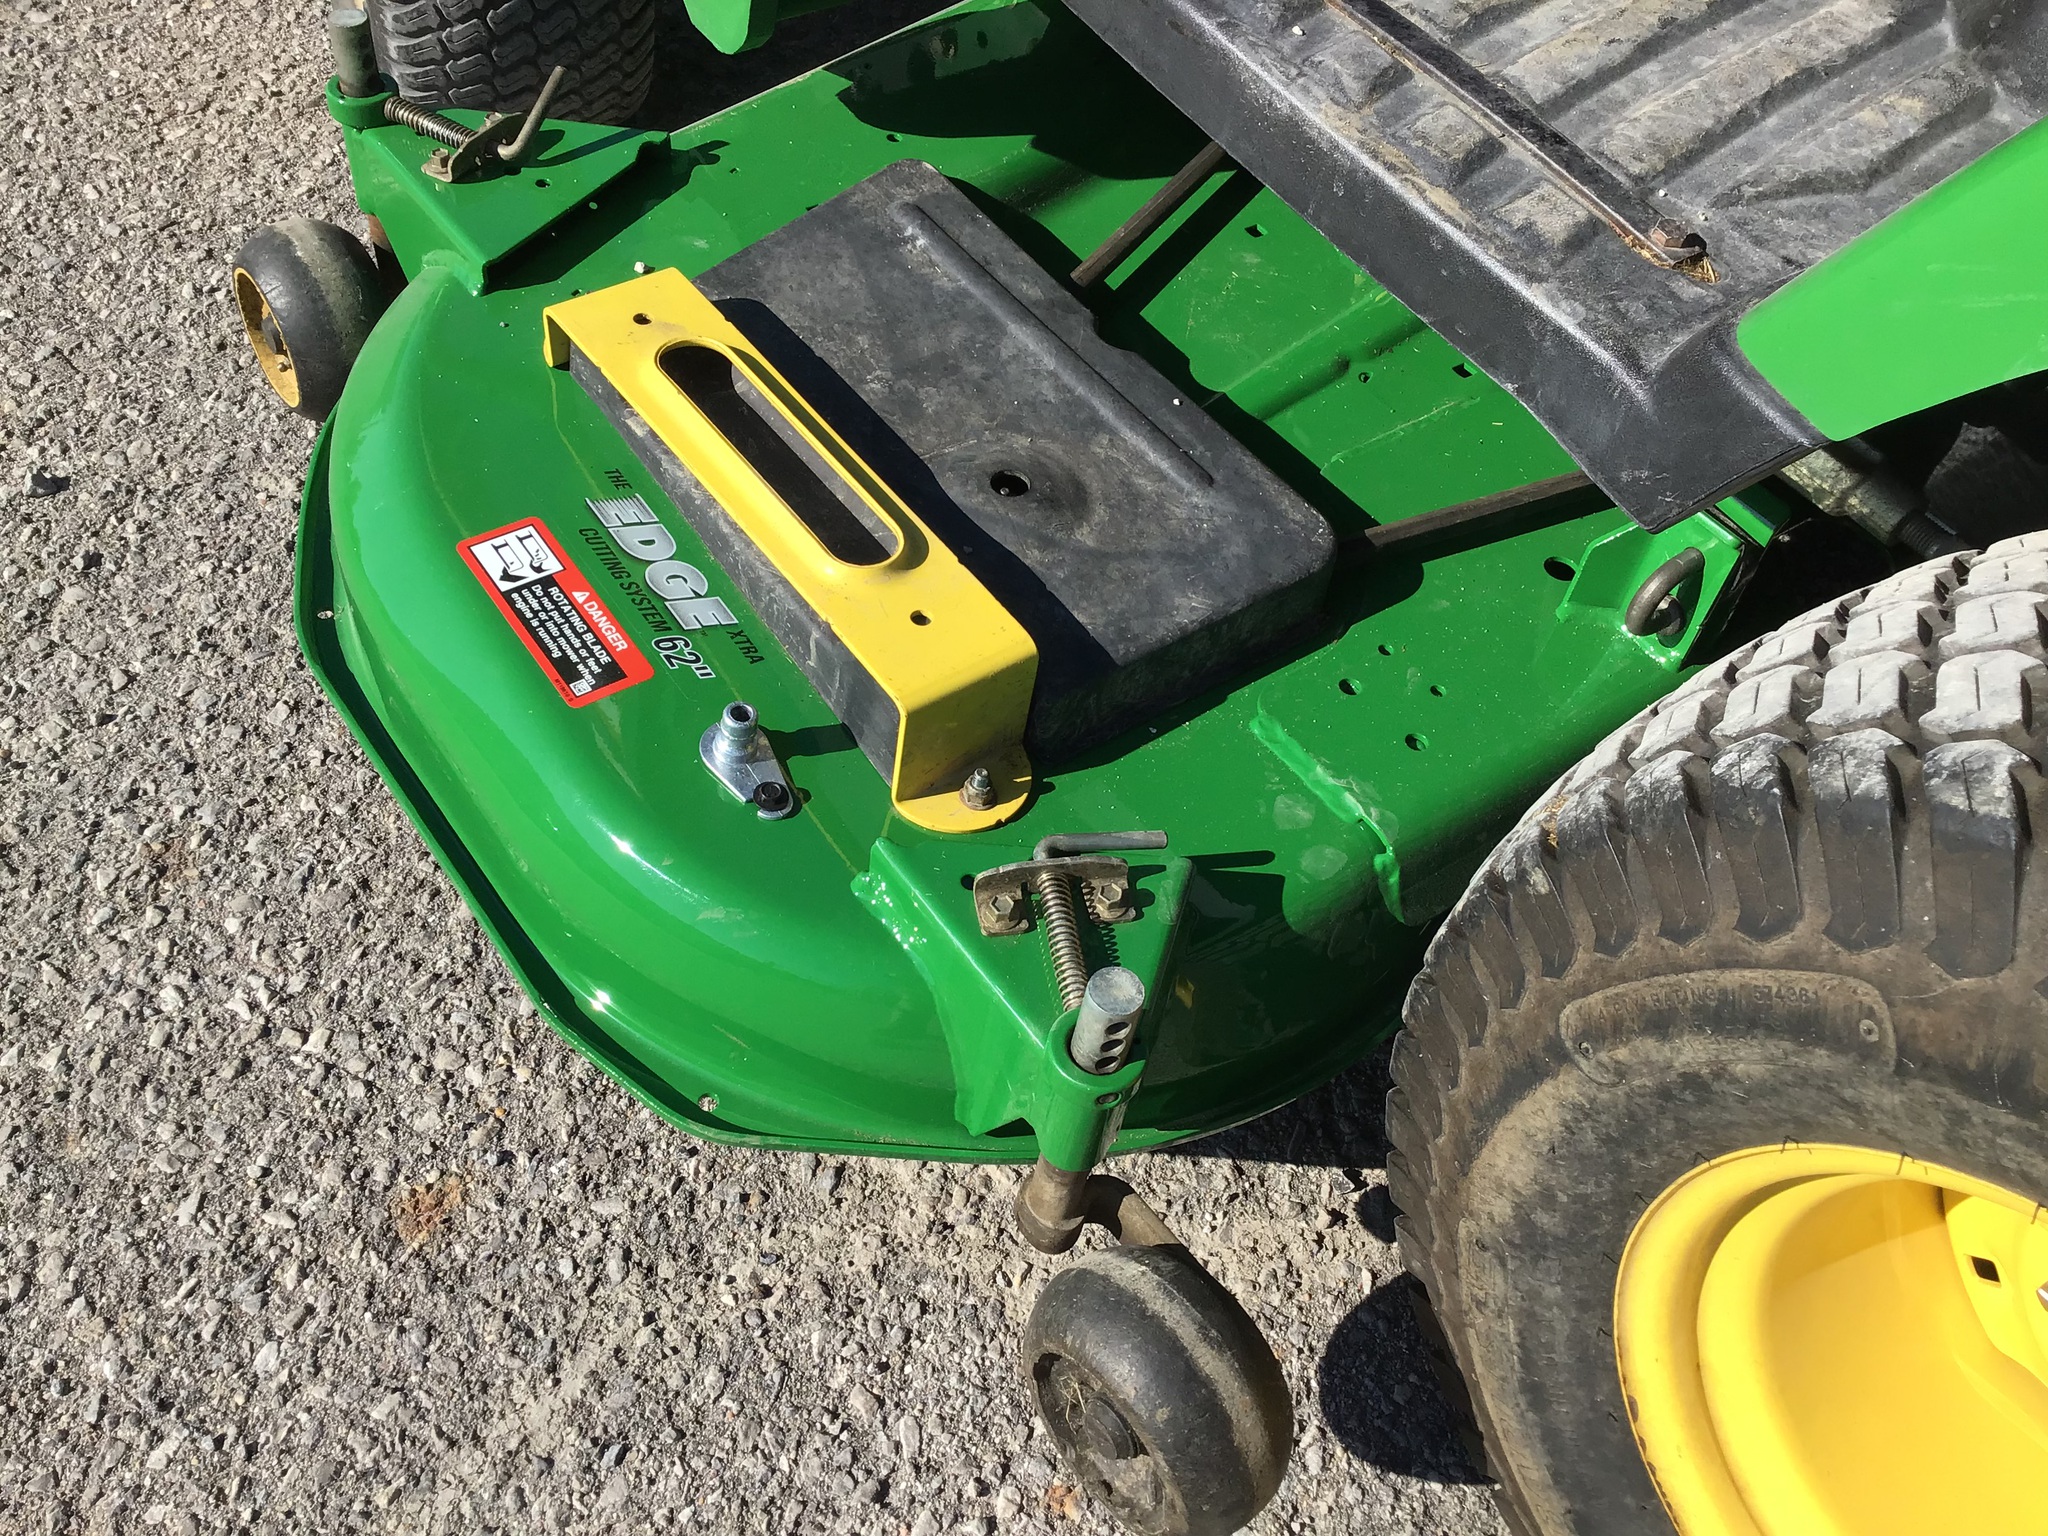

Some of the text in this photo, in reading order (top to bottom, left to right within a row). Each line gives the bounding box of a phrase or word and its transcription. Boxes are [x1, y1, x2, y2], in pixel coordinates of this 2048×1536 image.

[578, 527, 716, 679] CUTTING SYSTEM 62"
[584, 468, 765, 665] THE EDGE XTRA
[511, 592, 562, 658] engine is running
[521, 588, 542, 611] under
[538, 610, 549, 621] or
[545, 620, 560, 637] into
[556, 637, 580, 663] mower
[576, 663, 596, 686] when
[531, 584, 603, 674] Do not put hands or feet
[548, 586, 612, 665] ROTATING BLADE
[583, 601, 628, 652] DANGER
